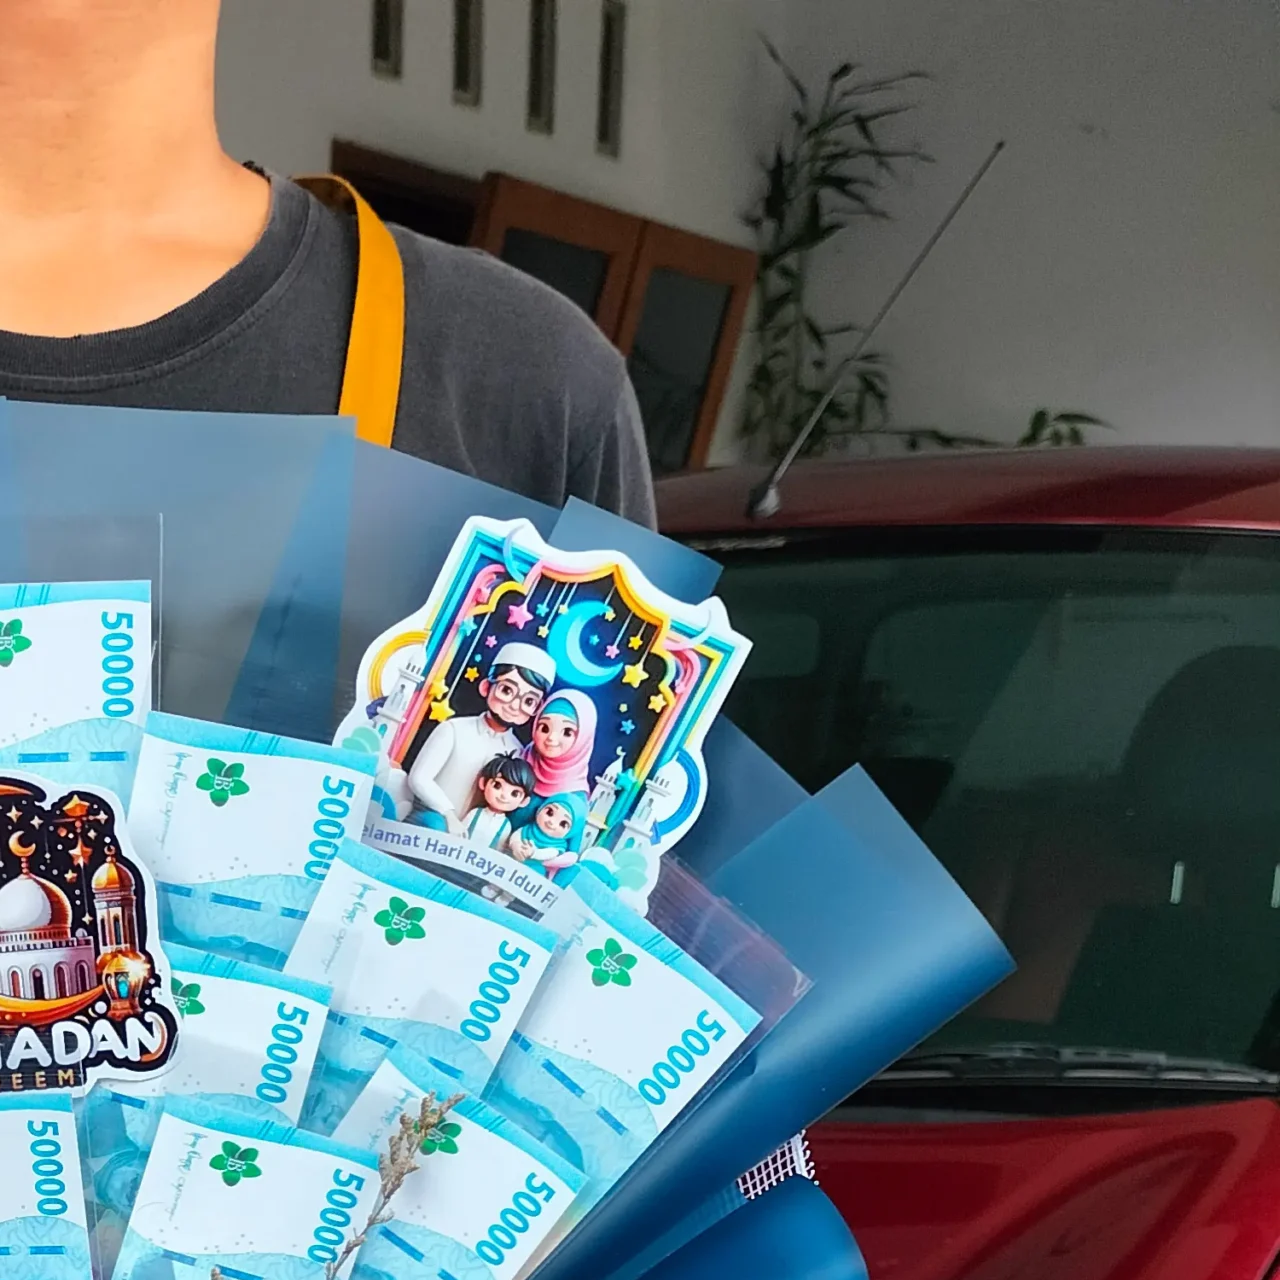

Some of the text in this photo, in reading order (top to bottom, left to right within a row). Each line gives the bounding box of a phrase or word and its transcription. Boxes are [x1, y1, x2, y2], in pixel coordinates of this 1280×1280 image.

[101, 611, 134, 718] 50000
[304, 775, 355, 881] 50000
[425, 837, 464, 860] Hari
[465, 849, 506, 879] Raya
[509, 867, 543, 897] Idul
[460, 940, 531, 1042] 50000
[256, 1002, 310, 1104] 50000
[639, 1010, 726, 1106] 50000
[27, 1120, 67, 1215] 50000
[307, 1168, 365, 1263] 50000
[475, 1172, 555, 1266] 50000
